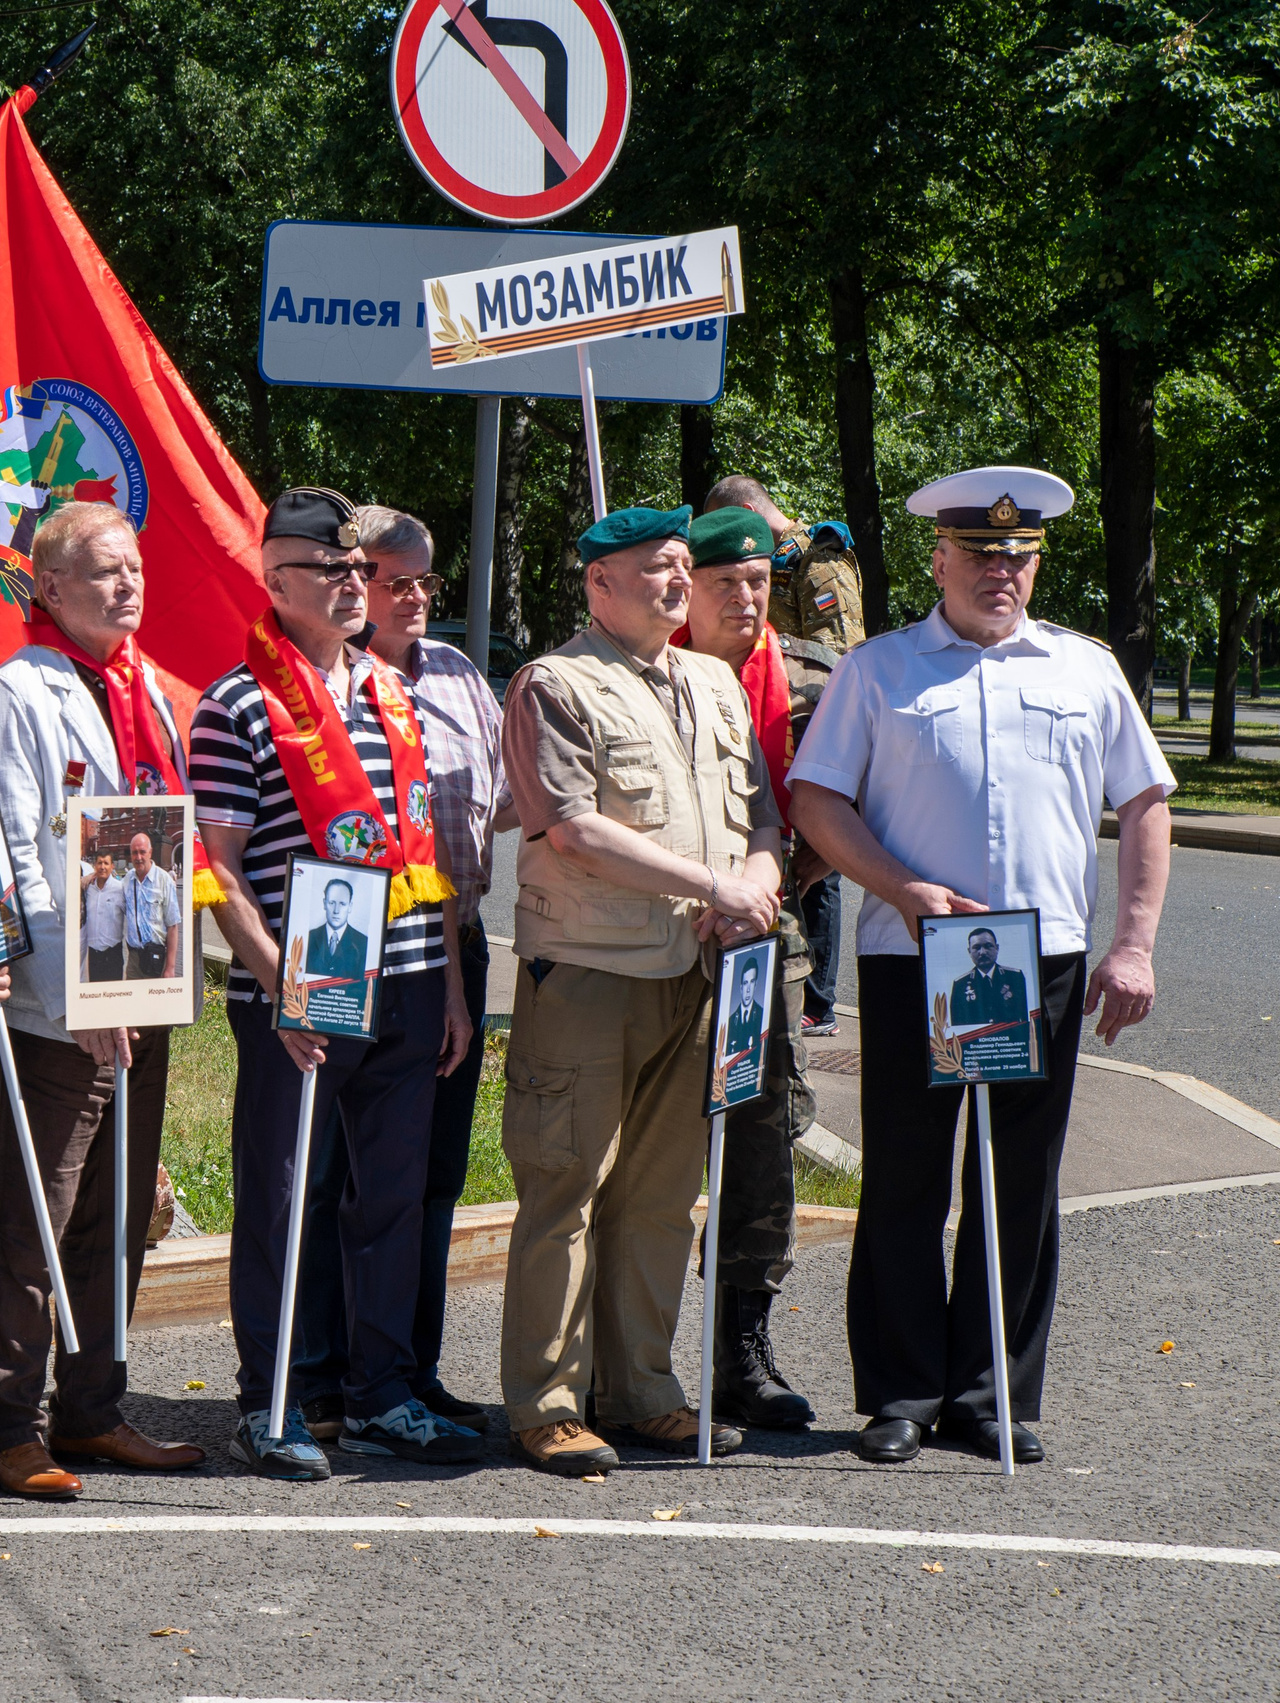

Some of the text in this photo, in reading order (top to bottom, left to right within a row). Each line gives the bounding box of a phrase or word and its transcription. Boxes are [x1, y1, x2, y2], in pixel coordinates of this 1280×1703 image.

[267, 286, 401, 327] Аллея
[475, 245, 693, 333] МОЗАМБИК
[49, 383, 142, 516] СОЮЗ ВЕТЕРАНОВ АНГОЛЫ
[102, 990, 132, 998] Кириченко
[148, 988, 165, 996] Игорь
